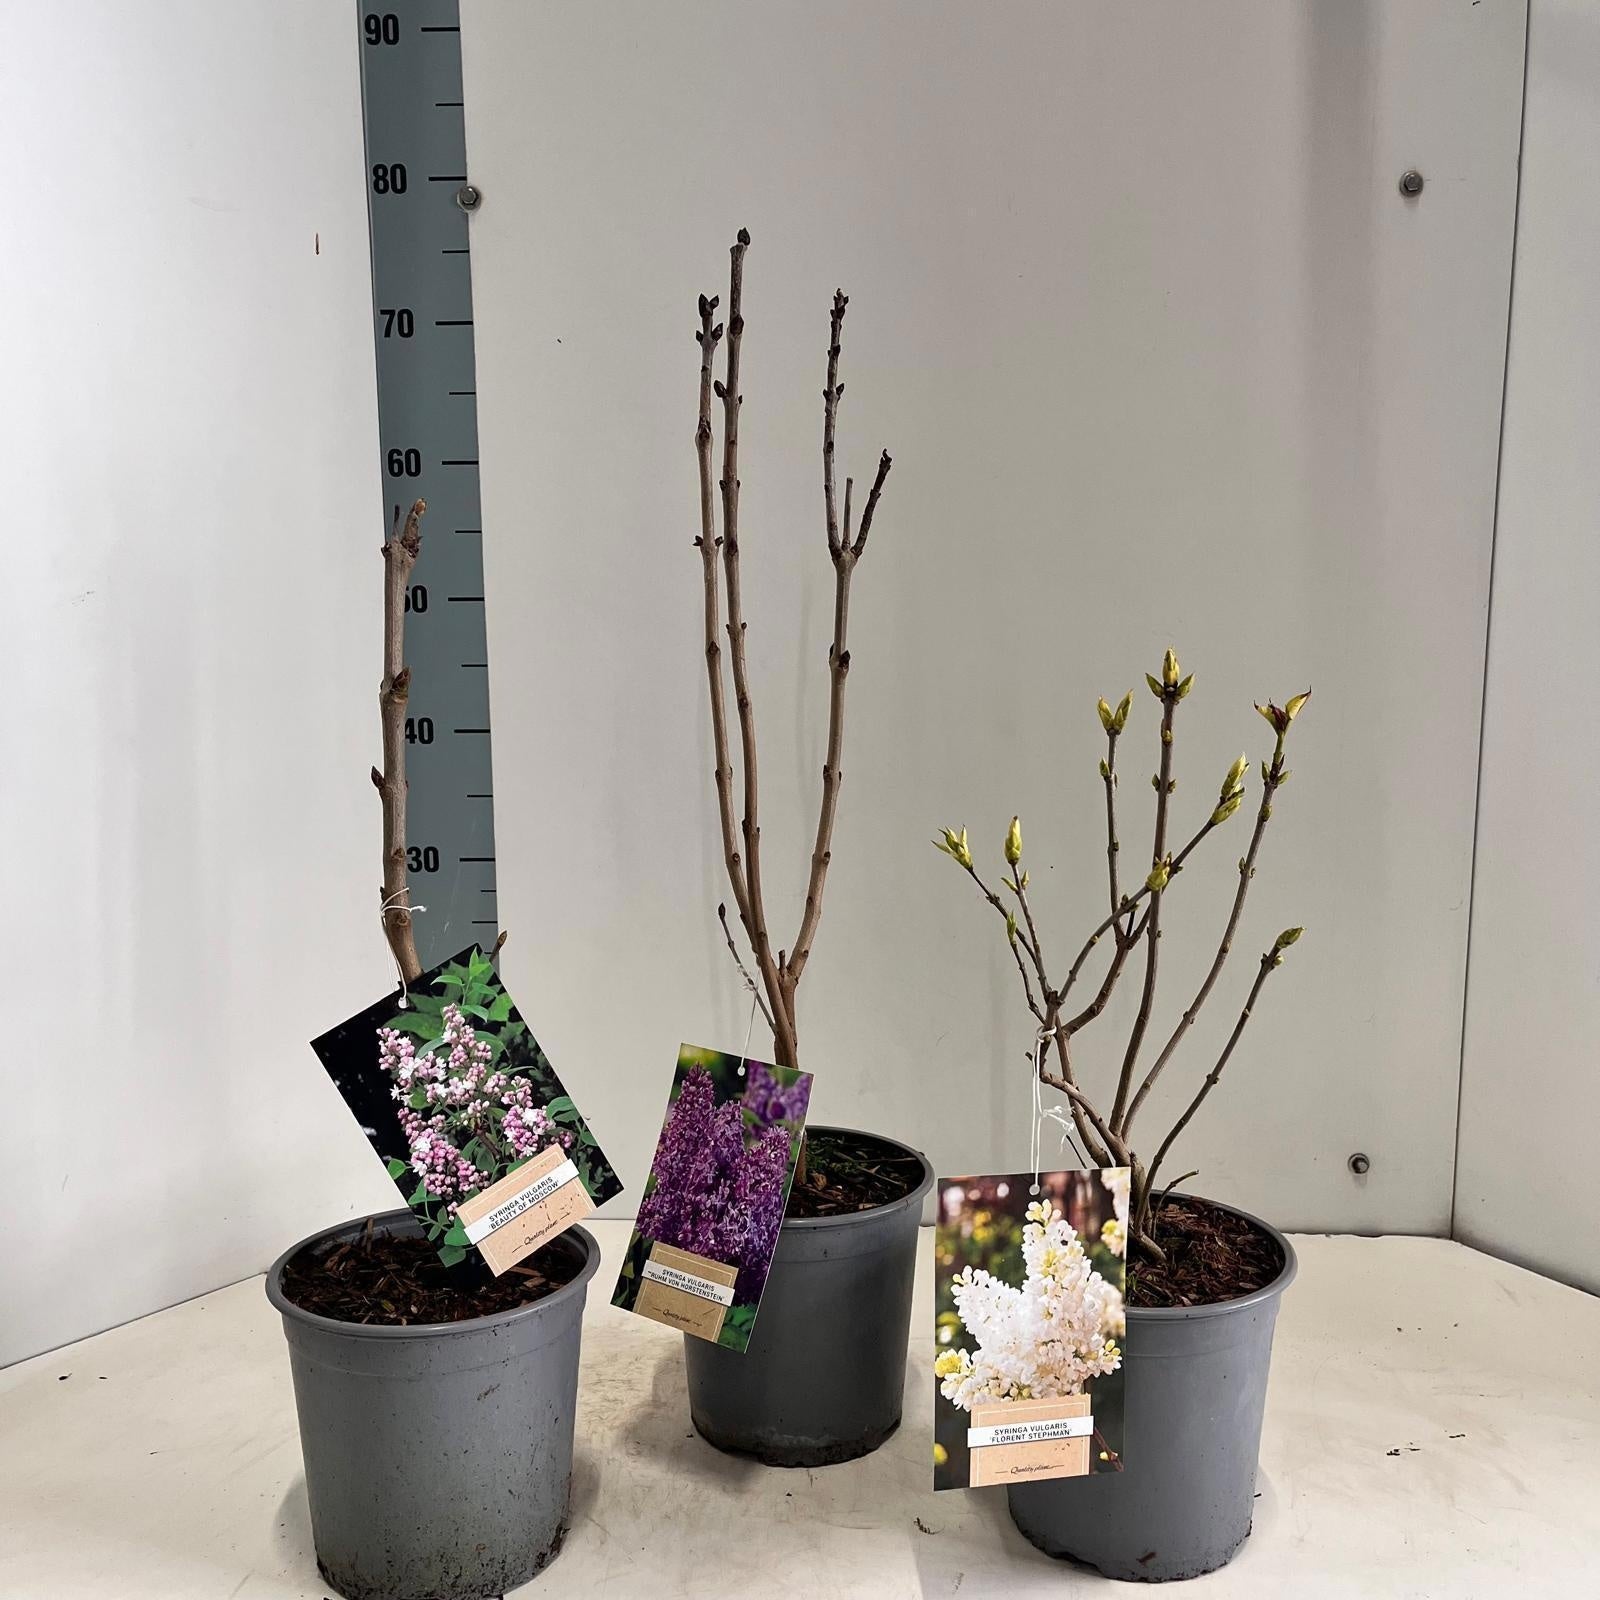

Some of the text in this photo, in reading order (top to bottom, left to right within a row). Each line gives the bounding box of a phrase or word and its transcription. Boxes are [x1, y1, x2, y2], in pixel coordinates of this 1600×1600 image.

[365, 14, 399, 45] 90
[372, 163, 407, 194] 80
[380, 308, 414, 338] 70
[387, 448, 421, 477] 60
[404, 717, 434, 745] 40
[406, 846, 440, 873] 30
[488, 1176, 554, 1222] SYRINGA VULGARIS
[517, 1202, 528, 1212] OF
[662, 1268, 715, 1292] SYRINGA VULGARIS
[668, 1279, 680, 1287] VON
[994, 1422, 1068, 1436] SYRINGA VULGARIS
